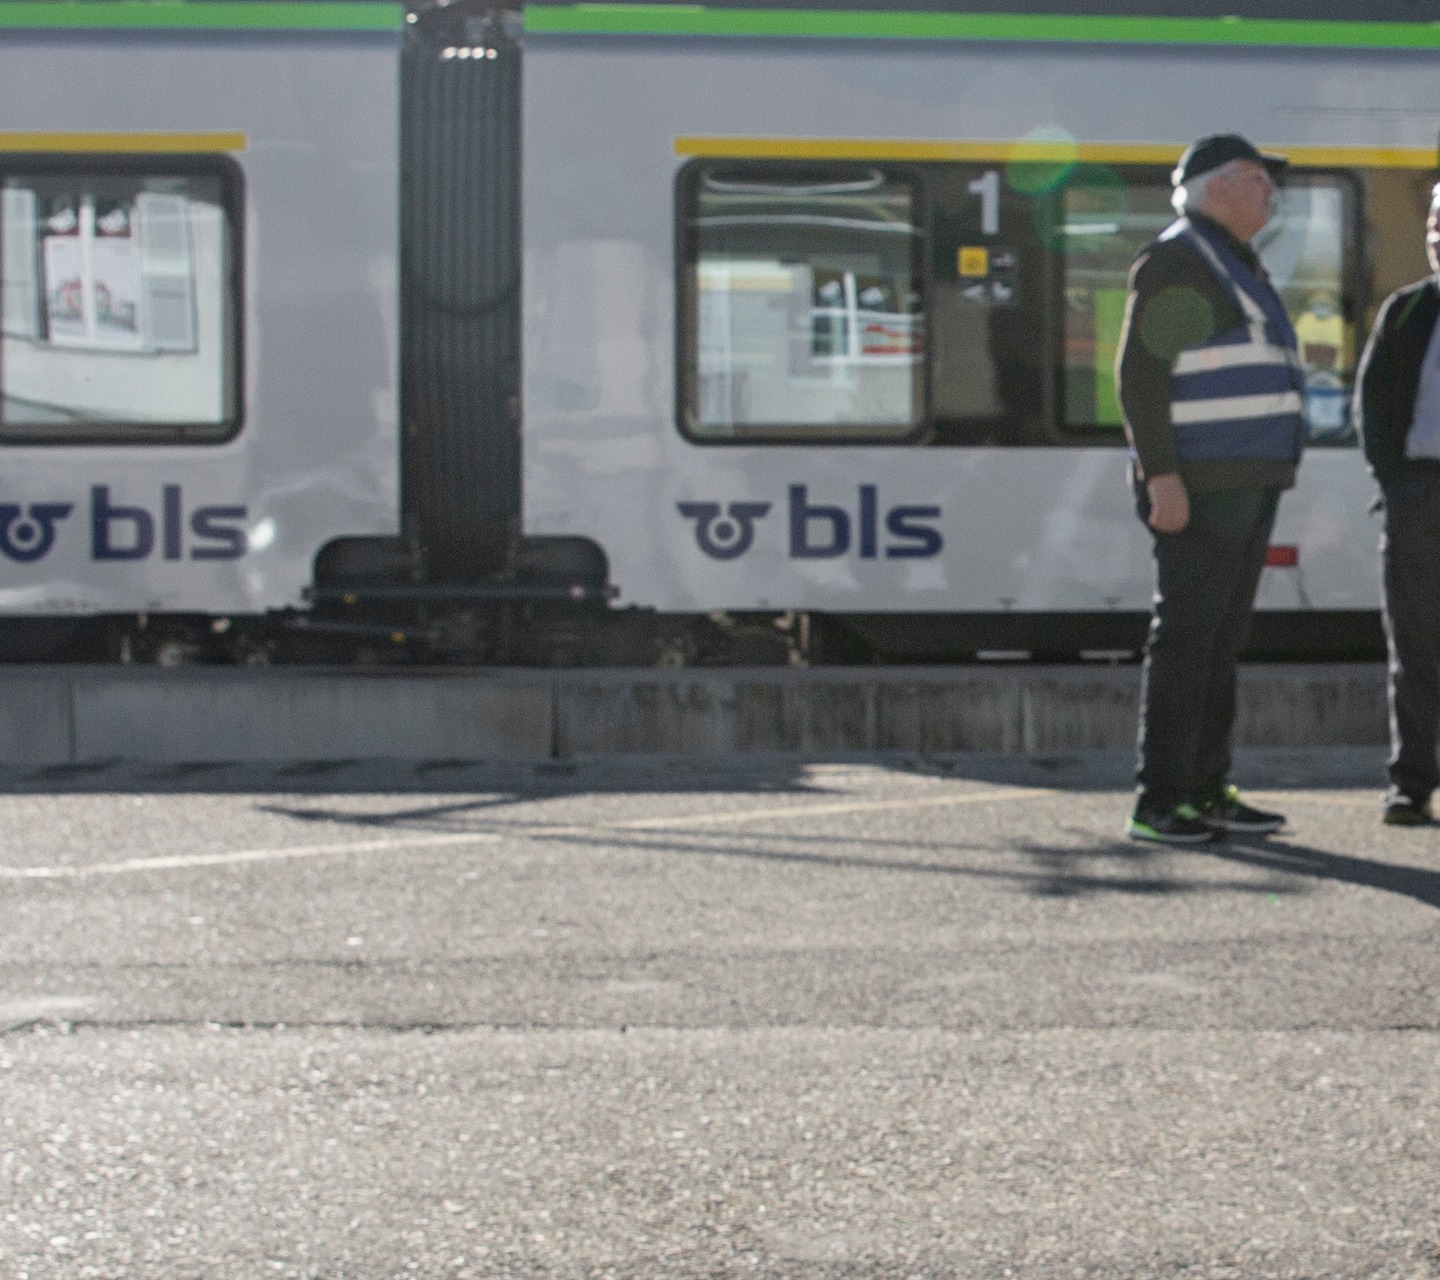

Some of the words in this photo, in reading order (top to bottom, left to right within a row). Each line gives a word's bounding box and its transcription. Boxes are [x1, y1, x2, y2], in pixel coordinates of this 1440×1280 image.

[967, 170, 999, 235] 1
[93, 484, 248, 560] bls
[789, 483, 943, 559] bls
